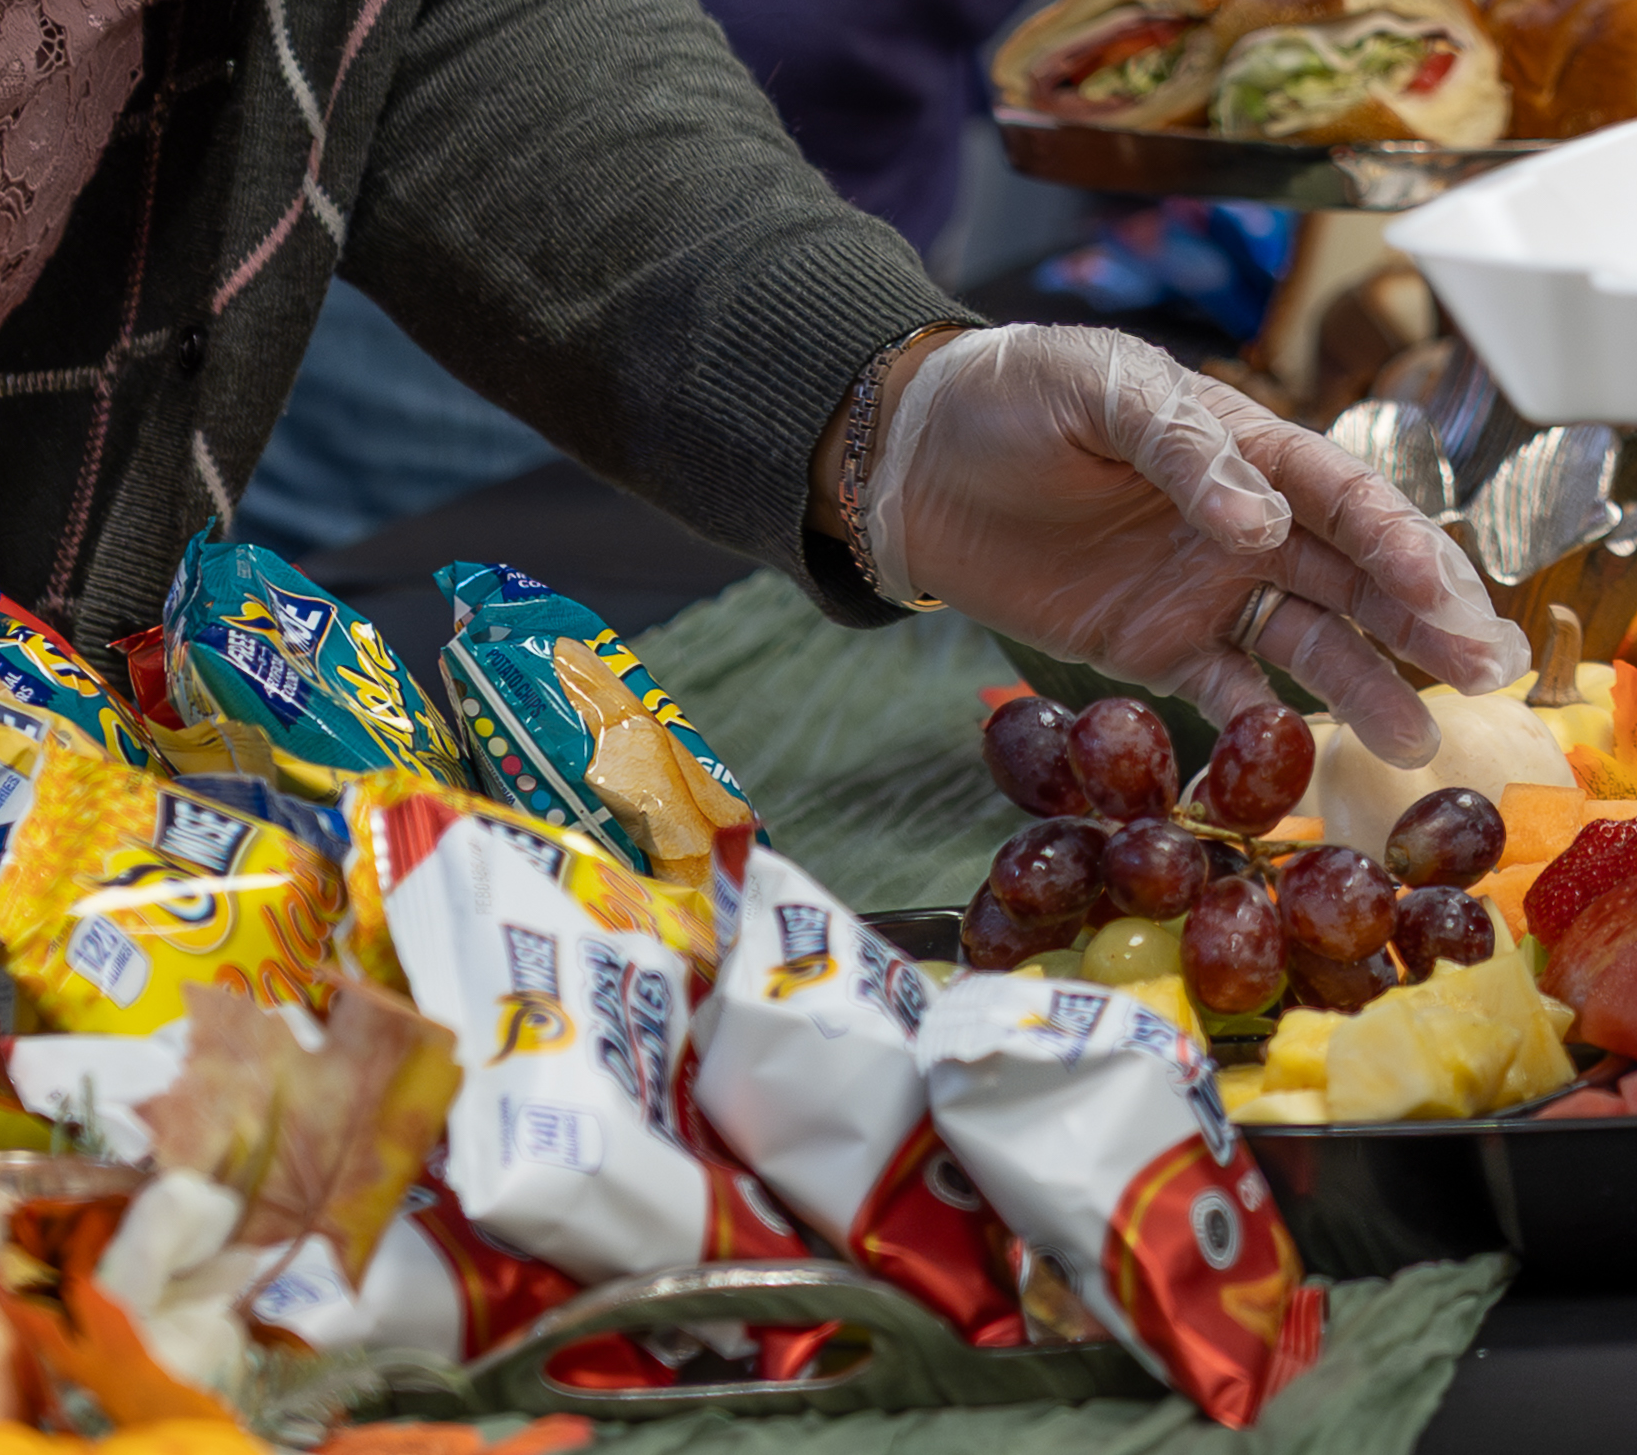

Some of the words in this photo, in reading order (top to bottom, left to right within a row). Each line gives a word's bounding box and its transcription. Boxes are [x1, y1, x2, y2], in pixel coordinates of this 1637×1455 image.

[227, 629, 256, 671] FREE
[485, 648, 523, 694] POTATO
[515, 681, 546, 720] CHIPS
[161, 800, 243, 872] WISE
[513, 931, 556, 992] WISE
